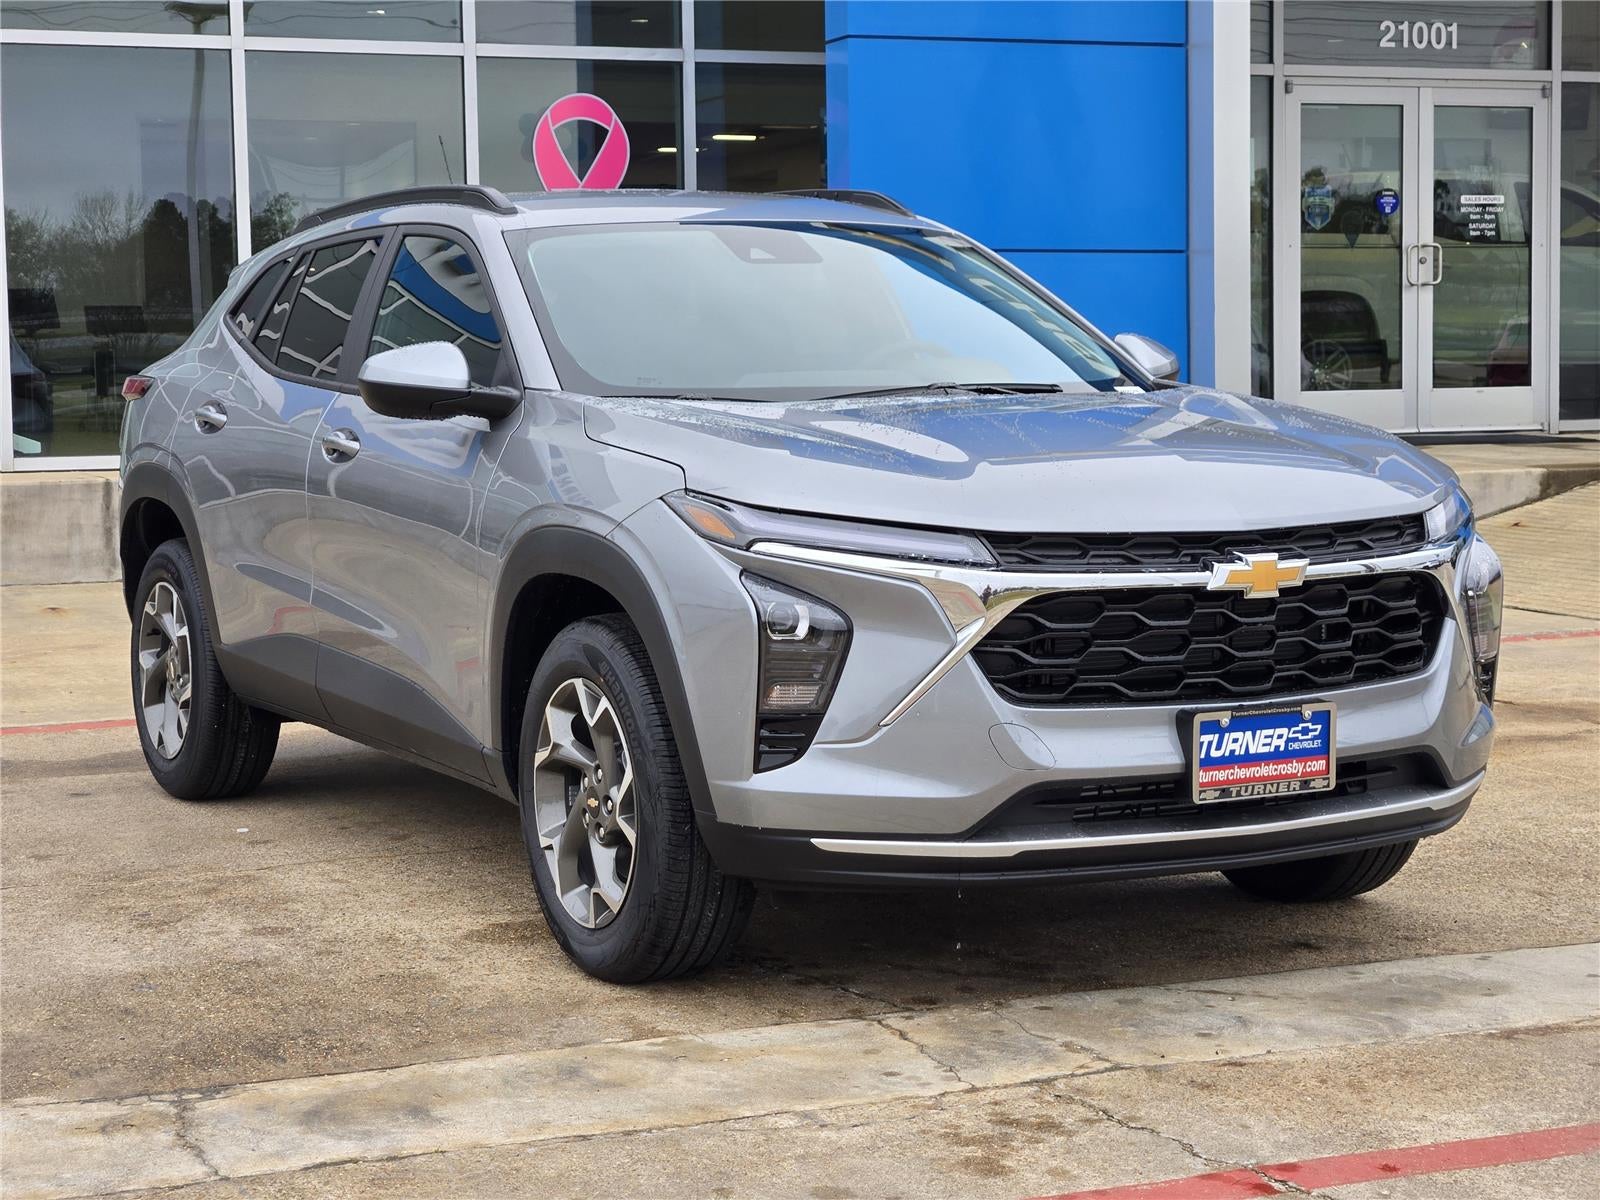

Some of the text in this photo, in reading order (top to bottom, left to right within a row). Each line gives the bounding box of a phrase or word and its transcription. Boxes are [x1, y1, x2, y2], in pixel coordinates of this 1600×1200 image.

[1379, 20, 1459, 49] 21001
[1200, 727, 1288, 759] TURNER
[1289, 739, 1322, 750] CHEVROLET
[1199, 759, 1326, 783] turnerchevroletcrosby.com
[1230, 781, 1301, 797] TURNER
